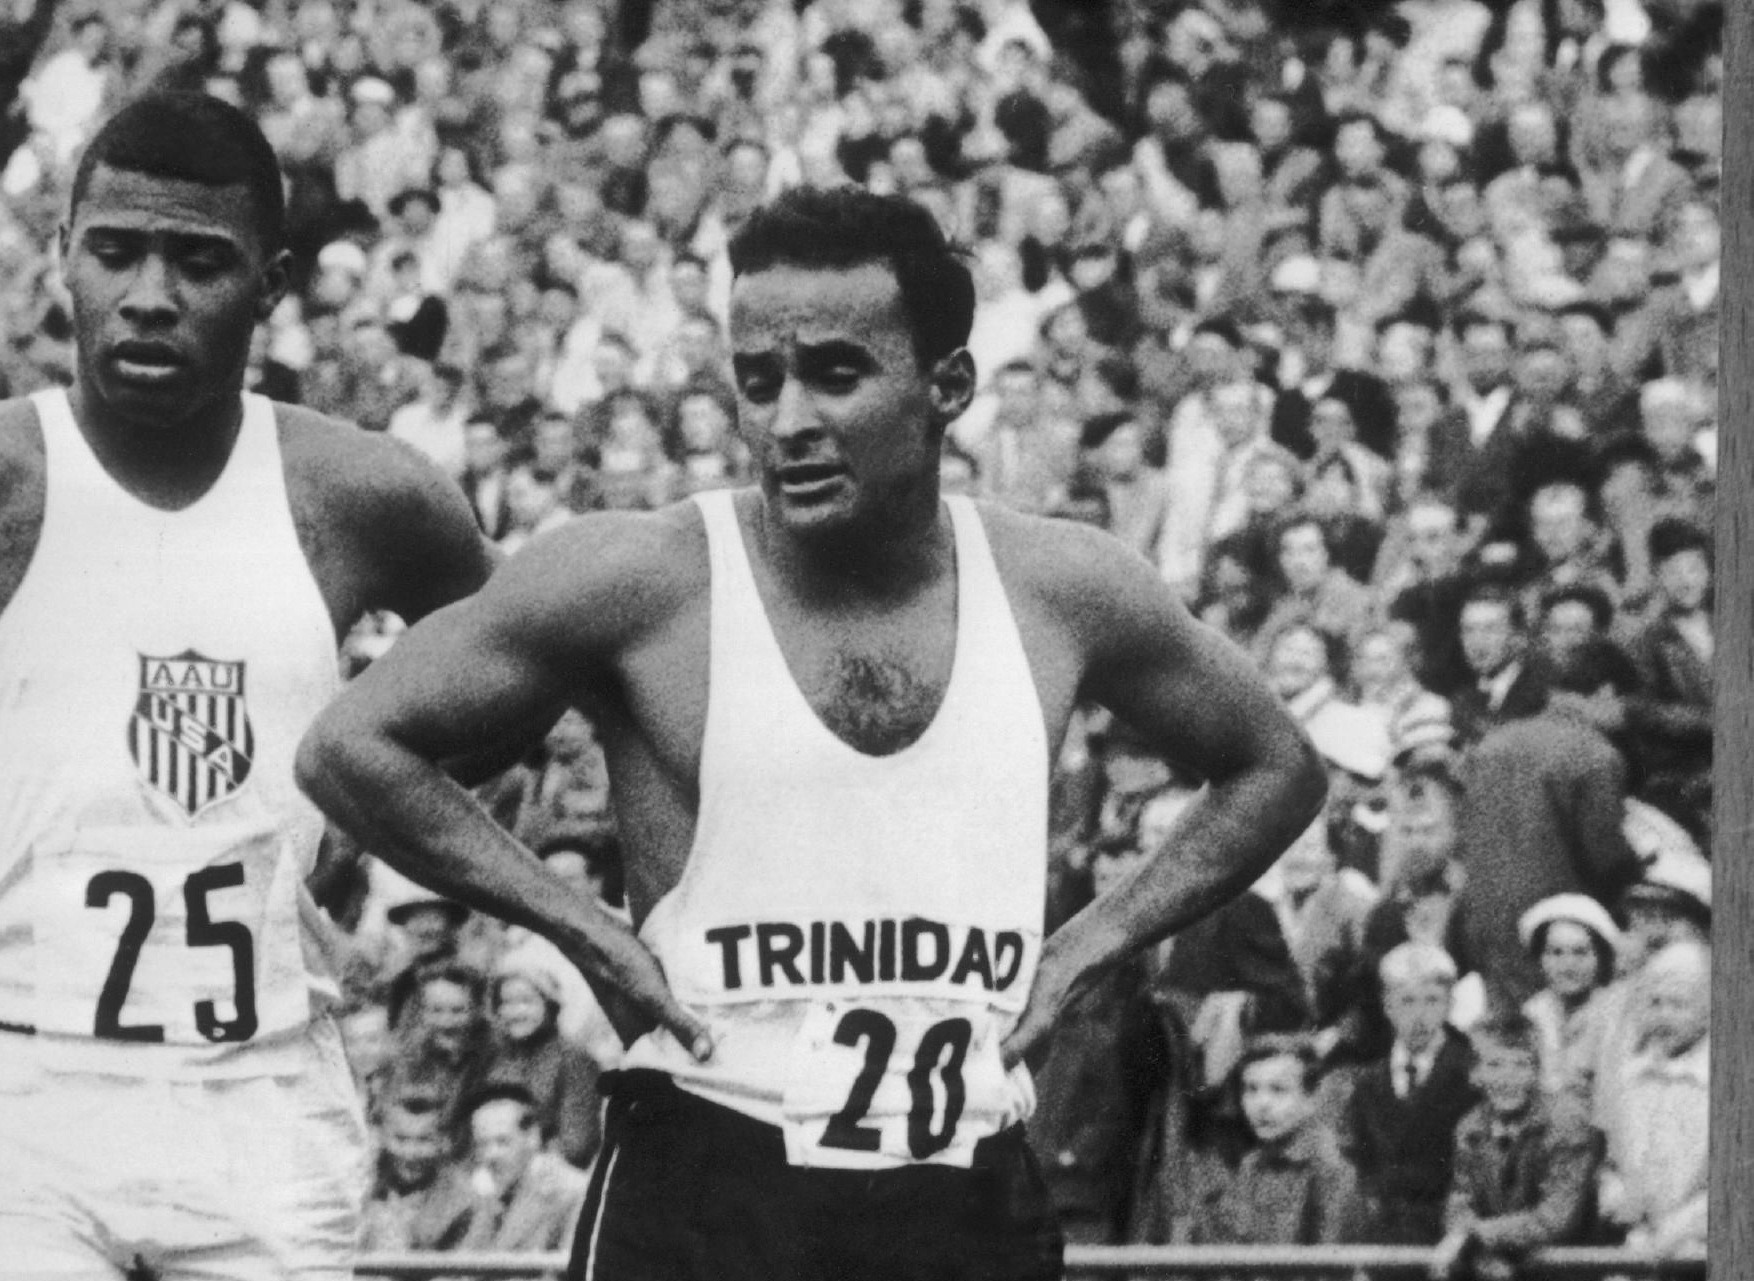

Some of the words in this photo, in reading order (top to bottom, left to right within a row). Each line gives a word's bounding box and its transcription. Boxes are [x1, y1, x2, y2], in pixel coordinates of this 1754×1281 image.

[152, 663, 233, 688] AAU
[150, 693, 234, 780] USA
[85, 861, 258, 1043] 25
[705, 915, 1024, 992] TRINIDAD
[817, 1008, 972, 1160] 20
